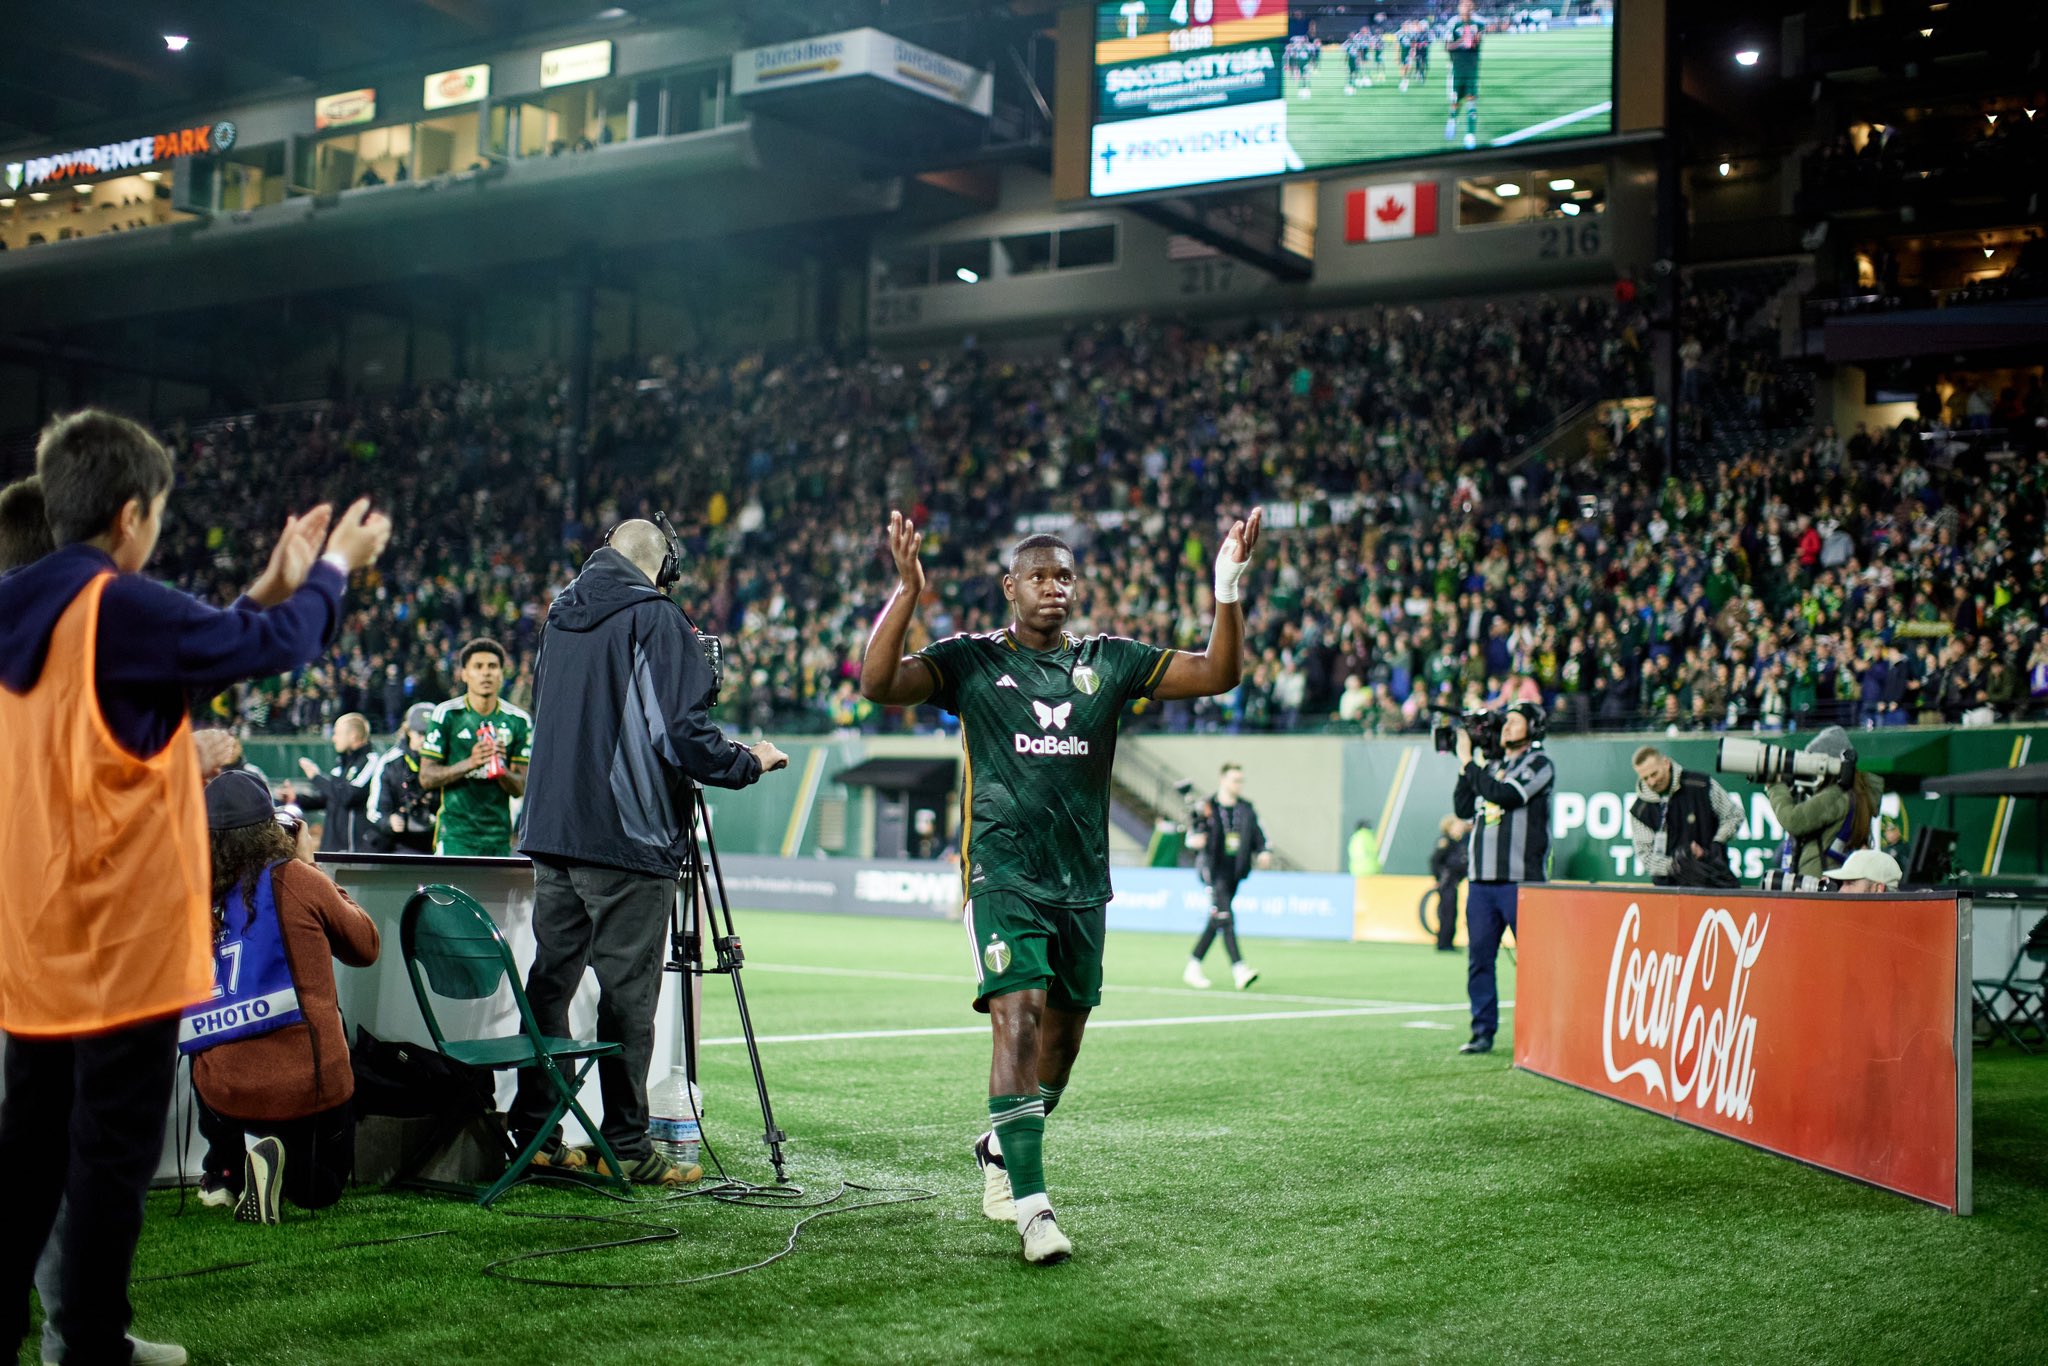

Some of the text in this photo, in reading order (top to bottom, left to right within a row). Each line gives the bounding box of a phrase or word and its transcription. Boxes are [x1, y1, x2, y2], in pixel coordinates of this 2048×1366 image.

[1125, 123, 1279, 161] PROVIDENCE
[1540, 222, 1599, 258] 216
[1015, 733, 1089, 755] DaBella
[191, 999, 271, 1035] PHOTO
